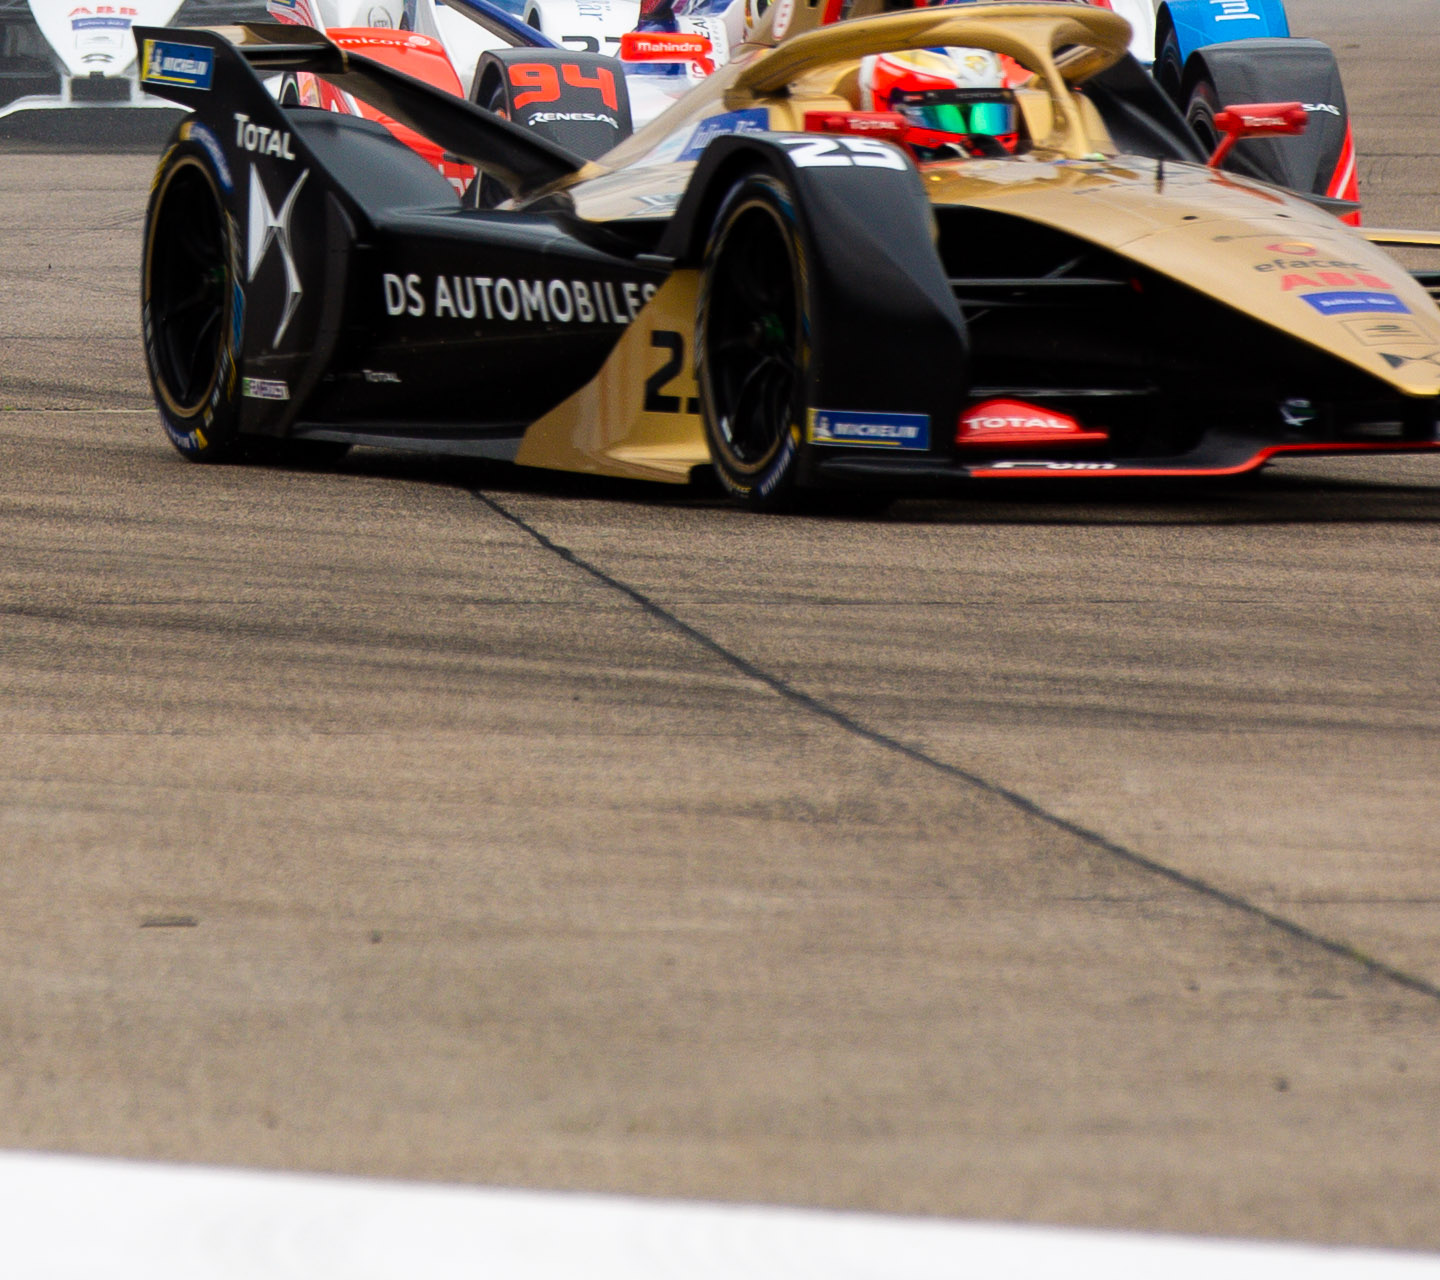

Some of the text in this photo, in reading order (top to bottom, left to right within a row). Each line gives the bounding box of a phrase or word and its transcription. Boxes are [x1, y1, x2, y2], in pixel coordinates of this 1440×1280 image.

[68, 6, 139, 17] ABB
[638, 41, 702, 52] Mahindra
[508, 64, 618, 111] 94
[528, 112, 619, 129] RENESAS
[848, 118, 900, 130] TOTAL
[233, 113, 295, 161] TOTAL
[779, 137, 908, 171] 25
[1254, 259, 1371, 272] efacec
[1280, 271, 1394, 292] ABB
[383, 273, 657, 324] DS AUTOMOBILES
[644, 330, 701, 414] 2
[835, 421, 919, 439] MICHELIN
[963, 416, 1073, 431] TOTAL
